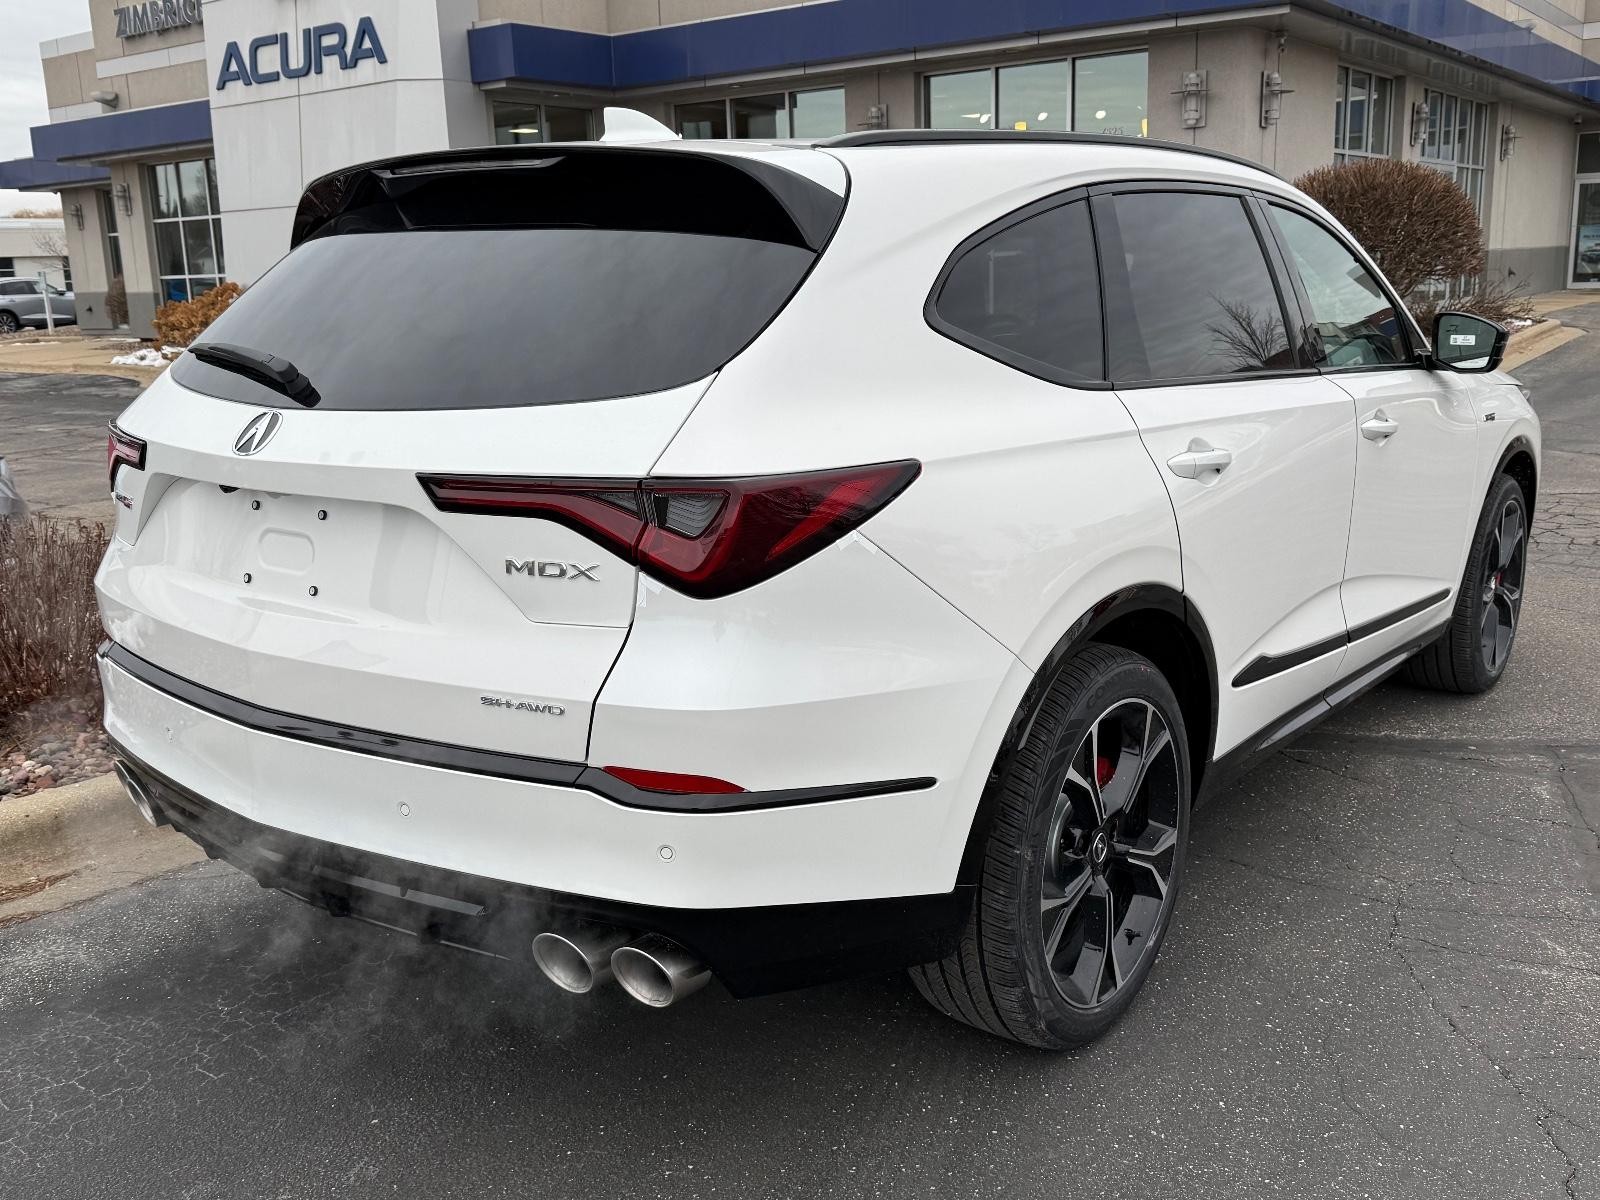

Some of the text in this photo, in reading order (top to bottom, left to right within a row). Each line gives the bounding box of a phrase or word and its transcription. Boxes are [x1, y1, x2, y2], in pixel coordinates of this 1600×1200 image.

[216, 16, 387, 91] ACURA
[504, 558, 601, 582] MDX
[480, 695, 565, 717] SH-AWD
